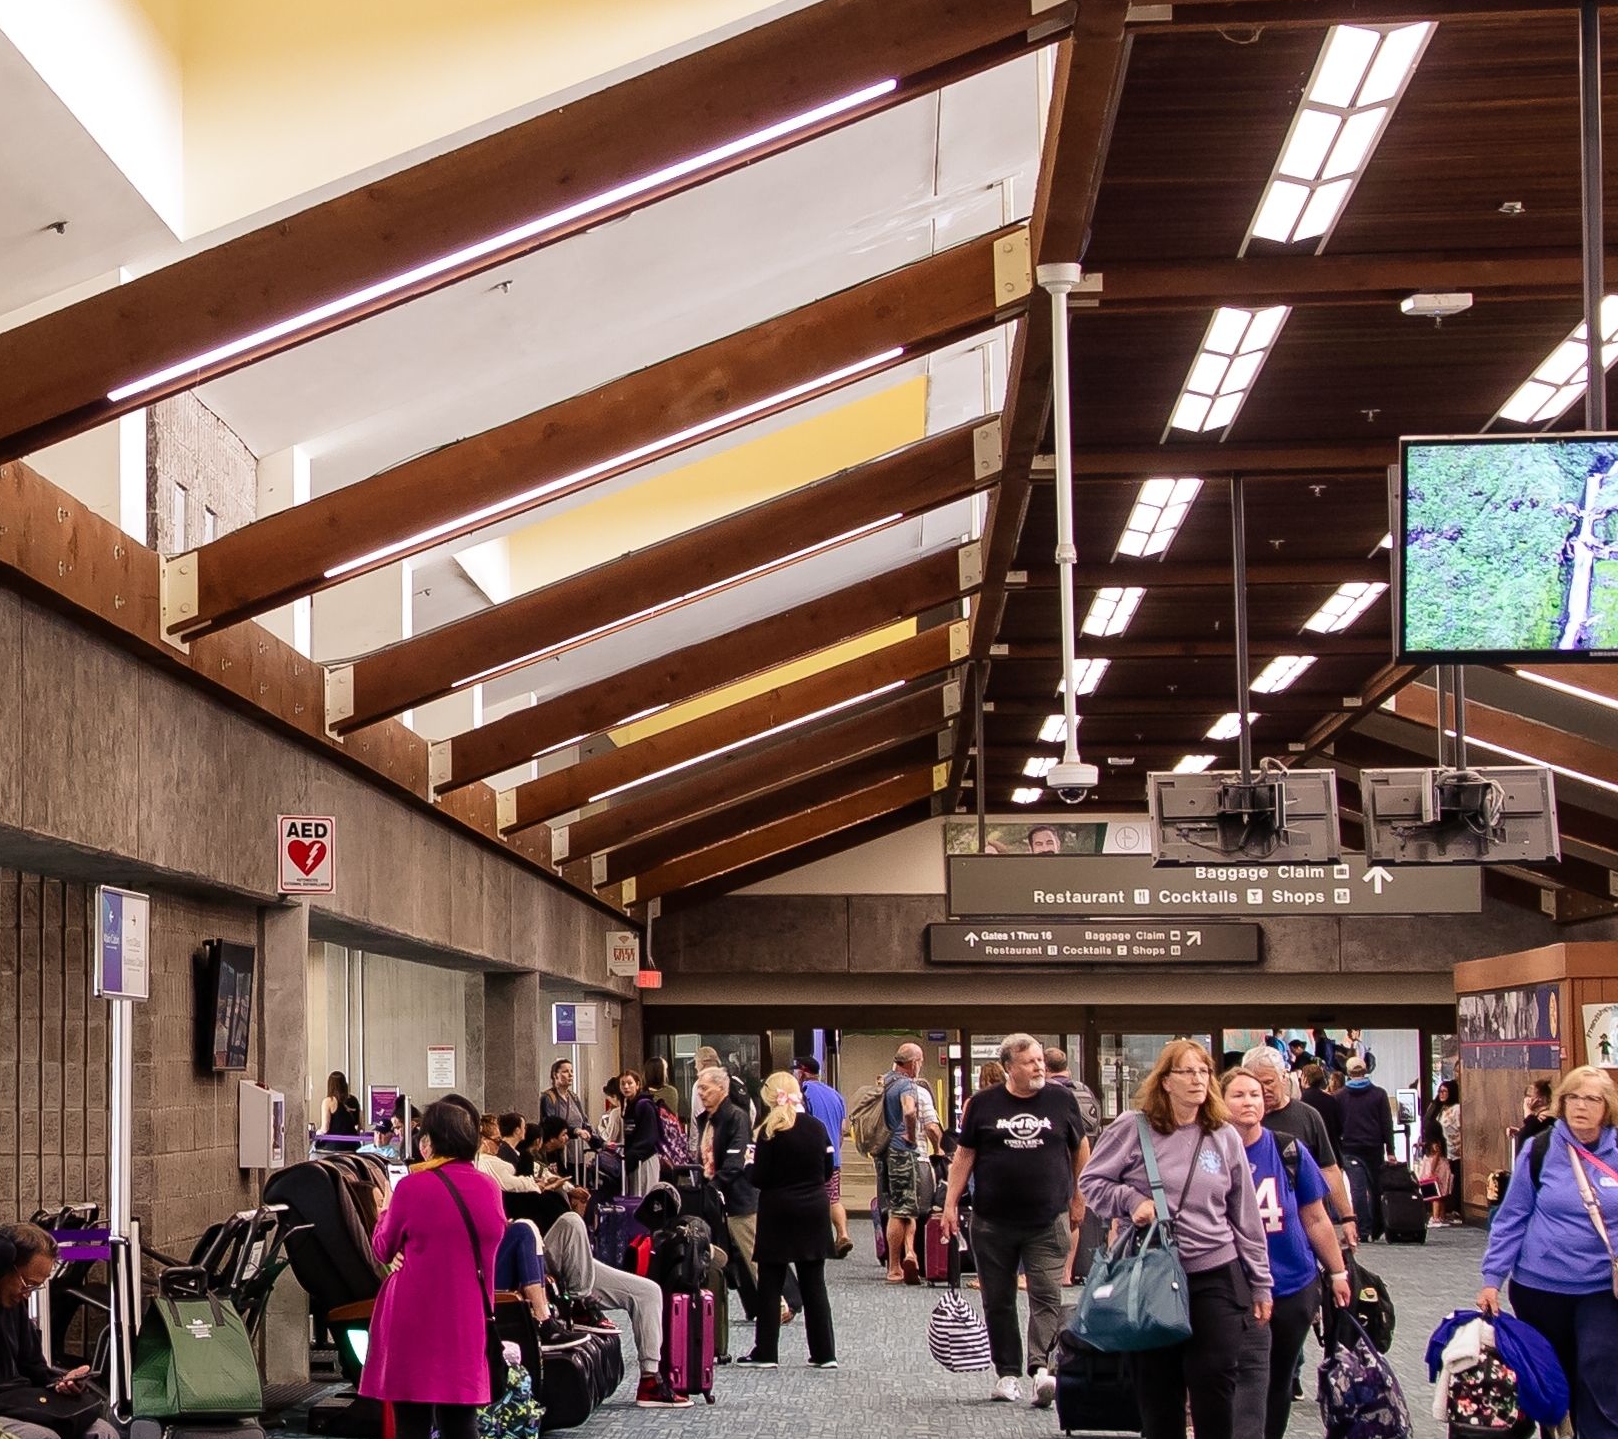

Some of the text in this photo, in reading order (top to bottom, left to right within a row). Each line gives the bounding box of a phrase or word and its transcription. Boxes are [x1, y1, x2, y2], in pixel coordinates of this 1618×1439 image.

[286, 822, 328, 838] AED
[1195, 865, 1325, 880] Baggage Claim
[1033, 890, 1325, 906] Restaurant Cocktails Shops
[981, 931, 1053, 941] Gates 1 Thru 16
[1085, 931, 1165, 943] Baggage Claim
[985, 945, 1166, 957] Restaurant Cocktails Shops
[996, 1117, 1052, 1130] Hard Rock
